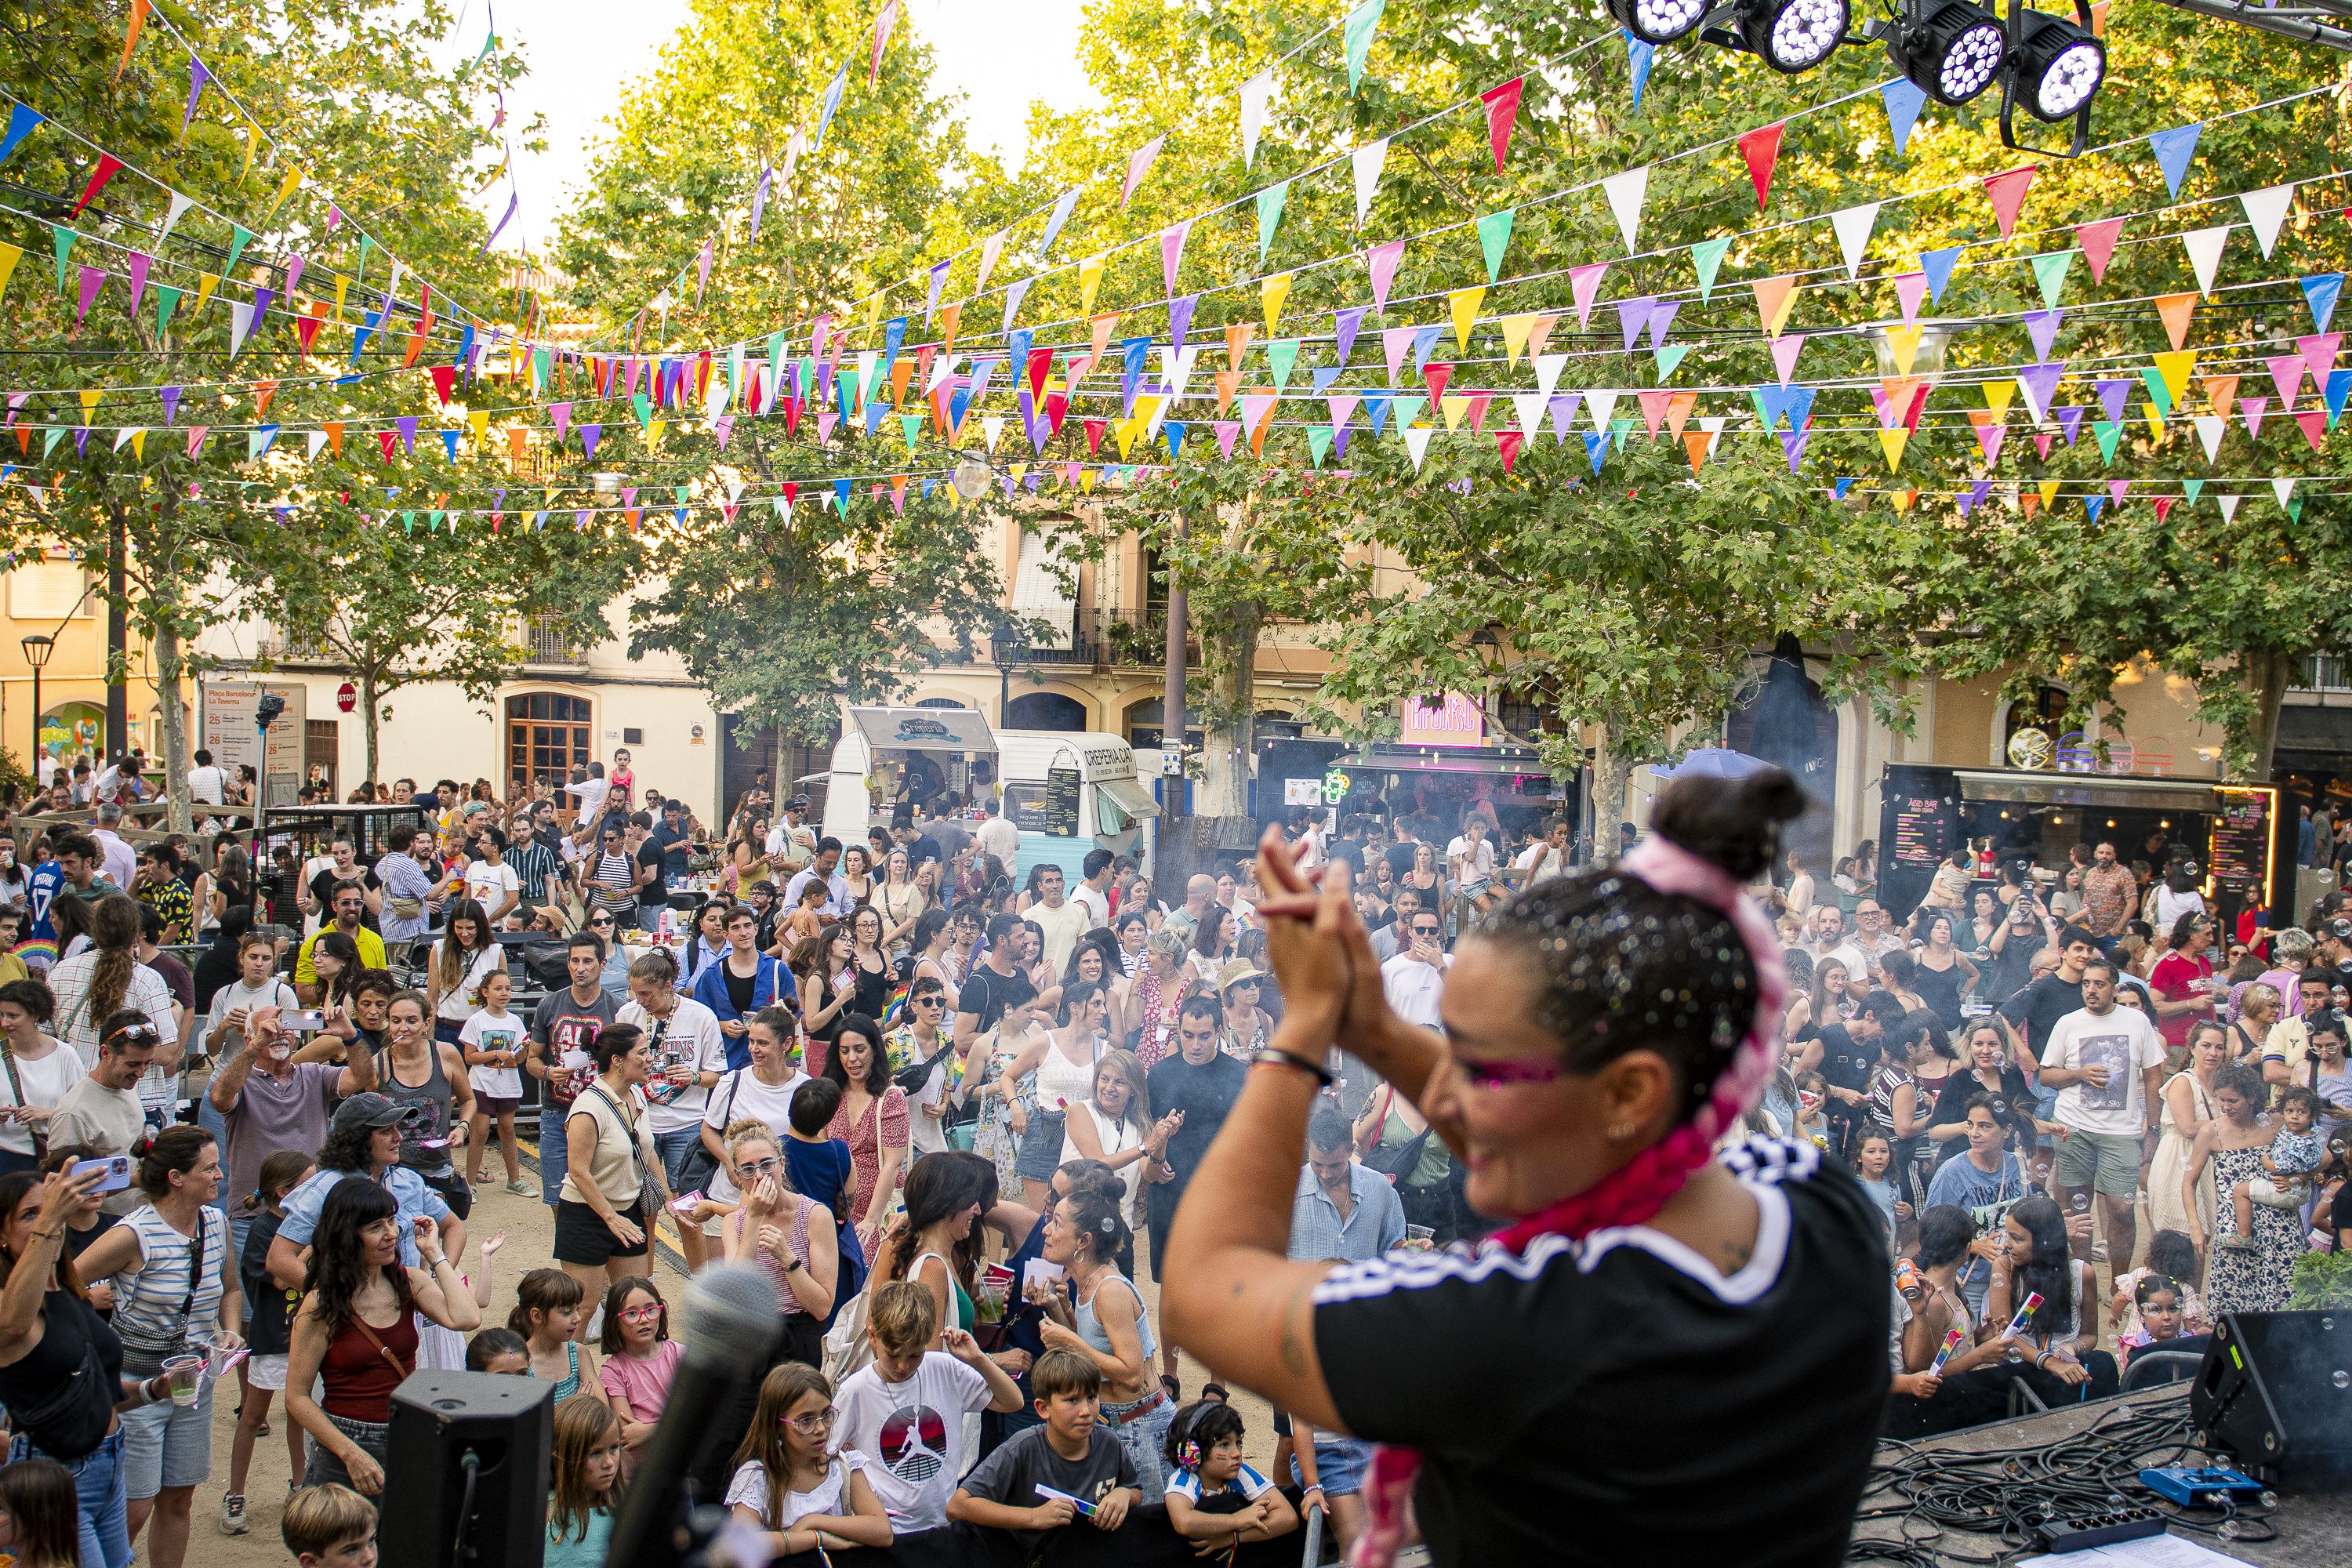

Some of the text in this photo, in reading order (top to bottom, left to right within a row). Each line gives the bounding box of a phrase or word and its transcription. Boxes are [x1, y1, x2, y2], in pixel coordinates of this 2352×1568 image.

[338, 694, 355, 702] STOP
[209, 716, 220, 724] 25
[269, 725, 278, 734] 25
[903, 722, 945, 735] Creperia
[209, 735, 220, 745] 26
[269, 746, 278, 755] 26
[1084, 747, 1133, 767] CREPERIA.CAT
[1322, 785, 1347, 795] MOJITO
[1924, 800, 1938, 810] BAR
[32, 887, 53, 921] 17
[2107, 1099, 2122, 1108] Sky
